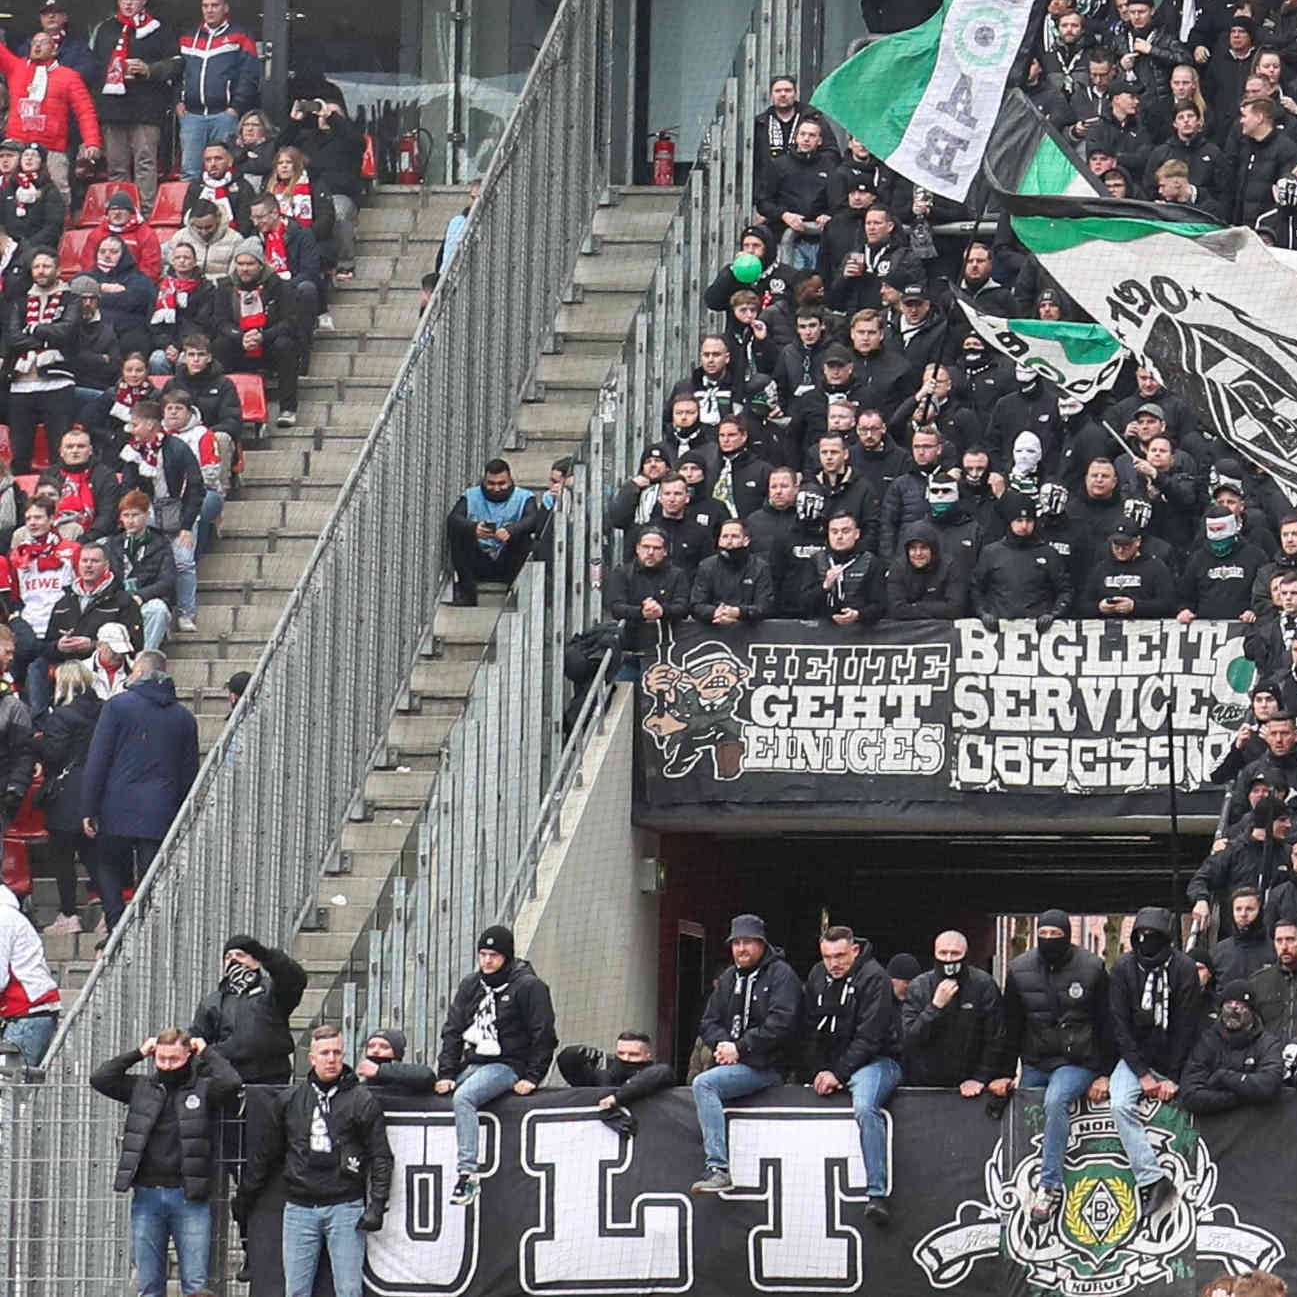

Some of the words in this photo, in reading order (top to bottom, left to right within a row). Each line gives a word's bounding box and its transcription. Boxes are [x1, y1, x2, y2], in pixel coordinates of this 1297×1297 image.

[747, 643, 950, 691] HEUTE
[953, 619, 1232, 675] BEGLEIT
[751, 686, 931, 729] GEHT
[951, 675, 1211, 732] SERVICE
[740, 722, 946, 776] EINIGES
[1079, 1121, 1117, 1134] NOR
